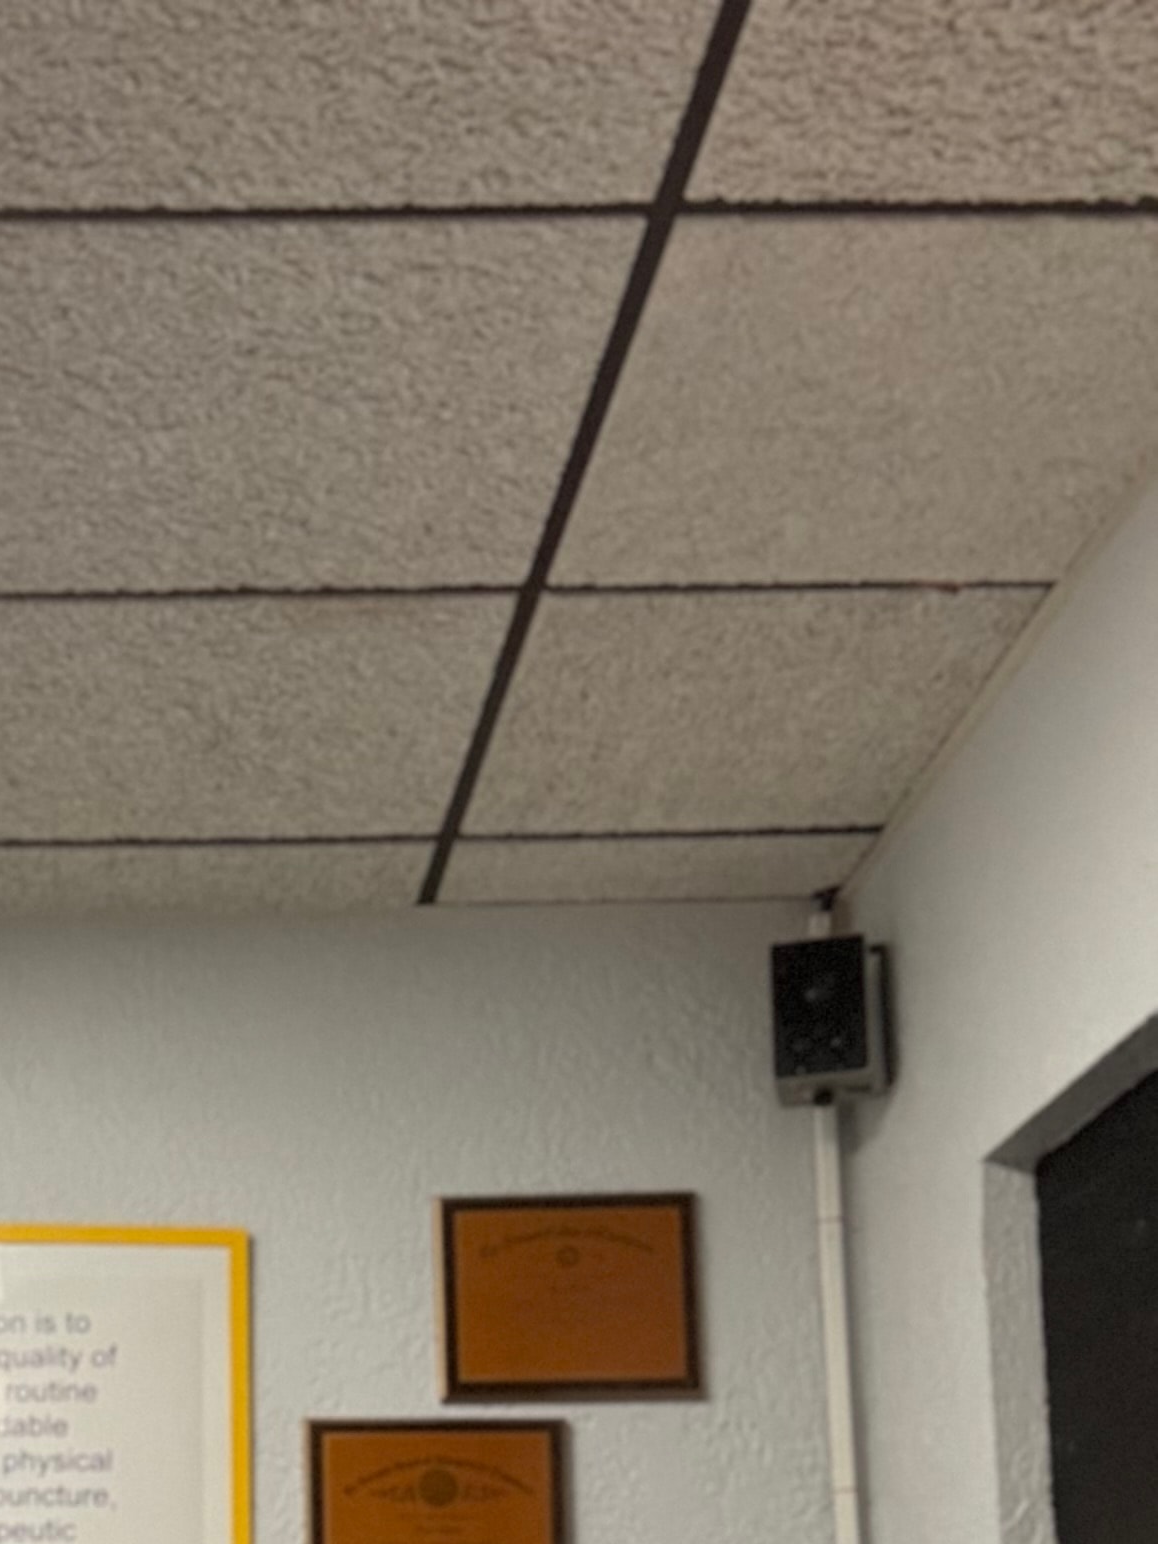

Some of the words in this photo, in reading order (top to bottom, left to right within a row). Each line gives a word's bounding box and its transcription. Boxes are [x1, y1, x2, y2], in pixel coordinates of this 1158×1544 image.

[34, 1311, 57, 1334] is
[66, 1312, 91, 1334] to
[90, 1343, 118, 1367] of
[4, 1381, 99, 1404] routine
[2, 1449, 114, 1476] physical
